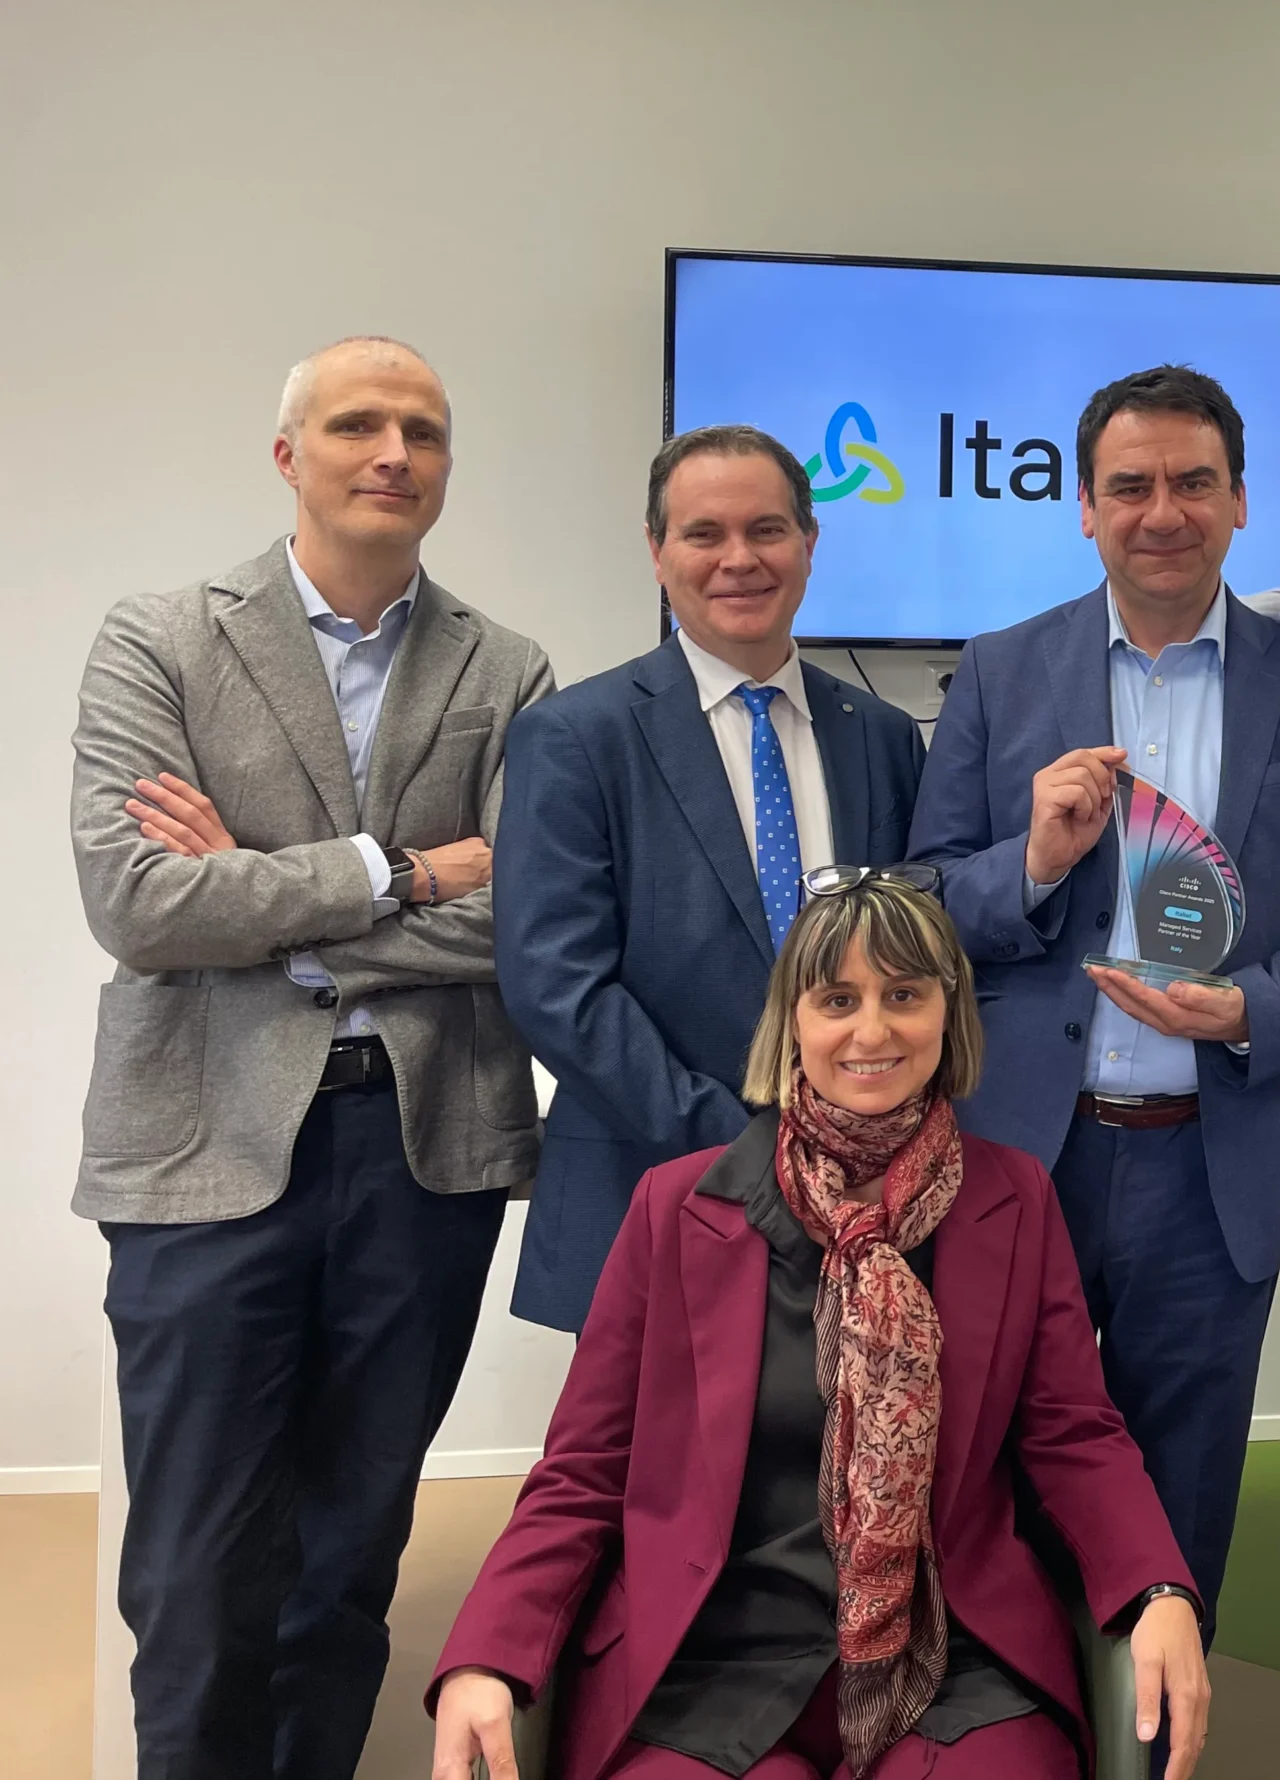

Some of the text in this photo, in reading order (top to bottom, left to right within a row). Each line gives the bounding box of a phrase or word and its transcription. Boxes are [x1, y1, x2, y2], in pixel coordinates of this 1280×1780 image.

[939, 413, 1082, 501] Ita
[1157, 928, 1175, 936] Partner
[1159, 921, 1202, 934] Managed Services
